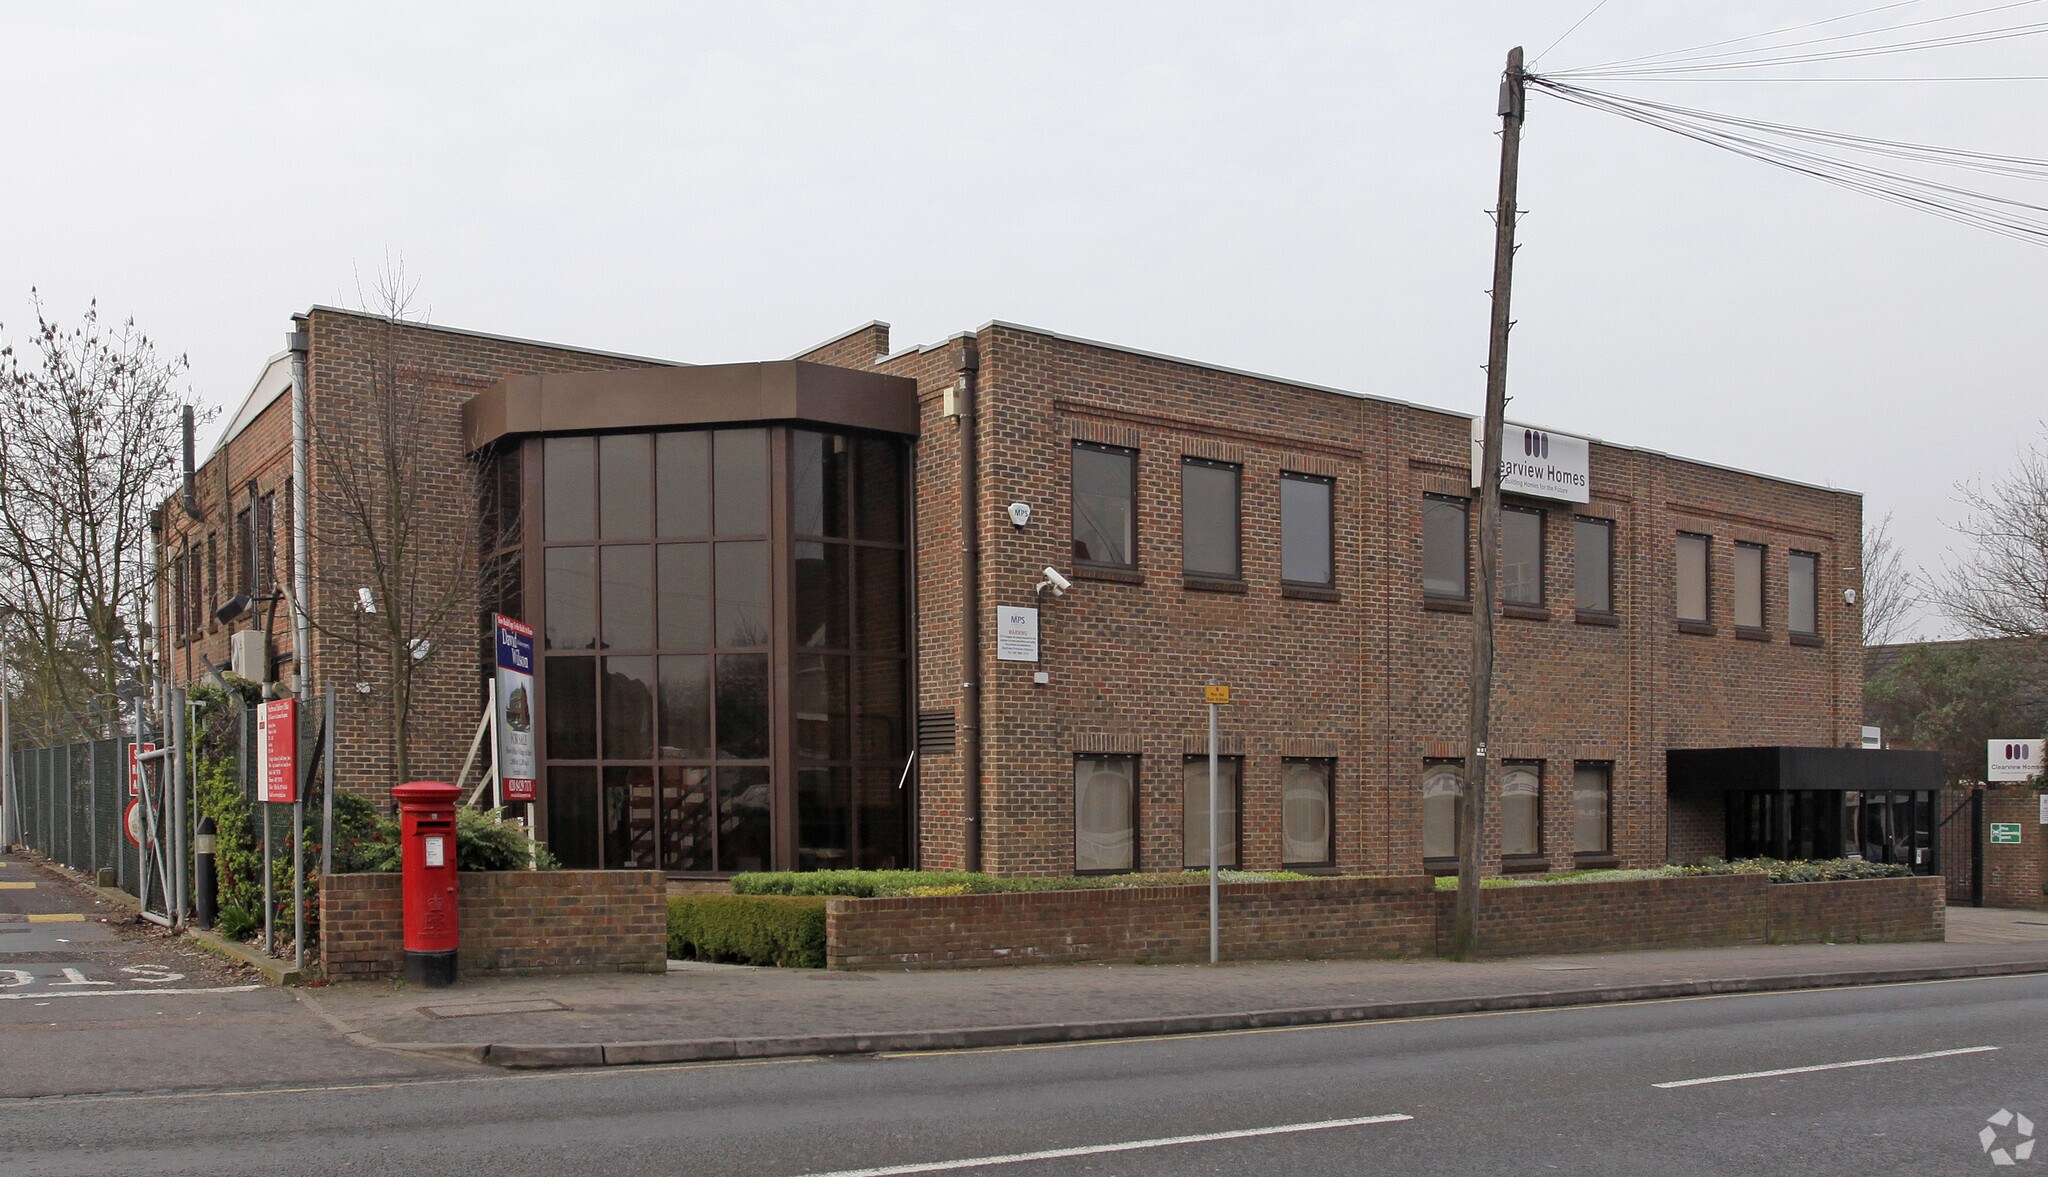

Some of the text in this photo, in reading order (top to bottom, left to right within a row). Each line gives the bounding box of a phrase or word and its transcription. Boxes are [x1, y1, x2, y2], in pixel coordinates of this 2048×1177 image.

[1500, 460, 1586, 487] earview Homes
[1524, 481, 1539, 490] Homes
[1546, 484, 1554, 493] the
[1014, 508, 1029, 518] MPS
[1010, 615, 1026, 625] MPS
[501, 627, 518, 648] David
[511, 647, 529, 669] Wilson
[1991, 763, 2021, 771] Clearview
